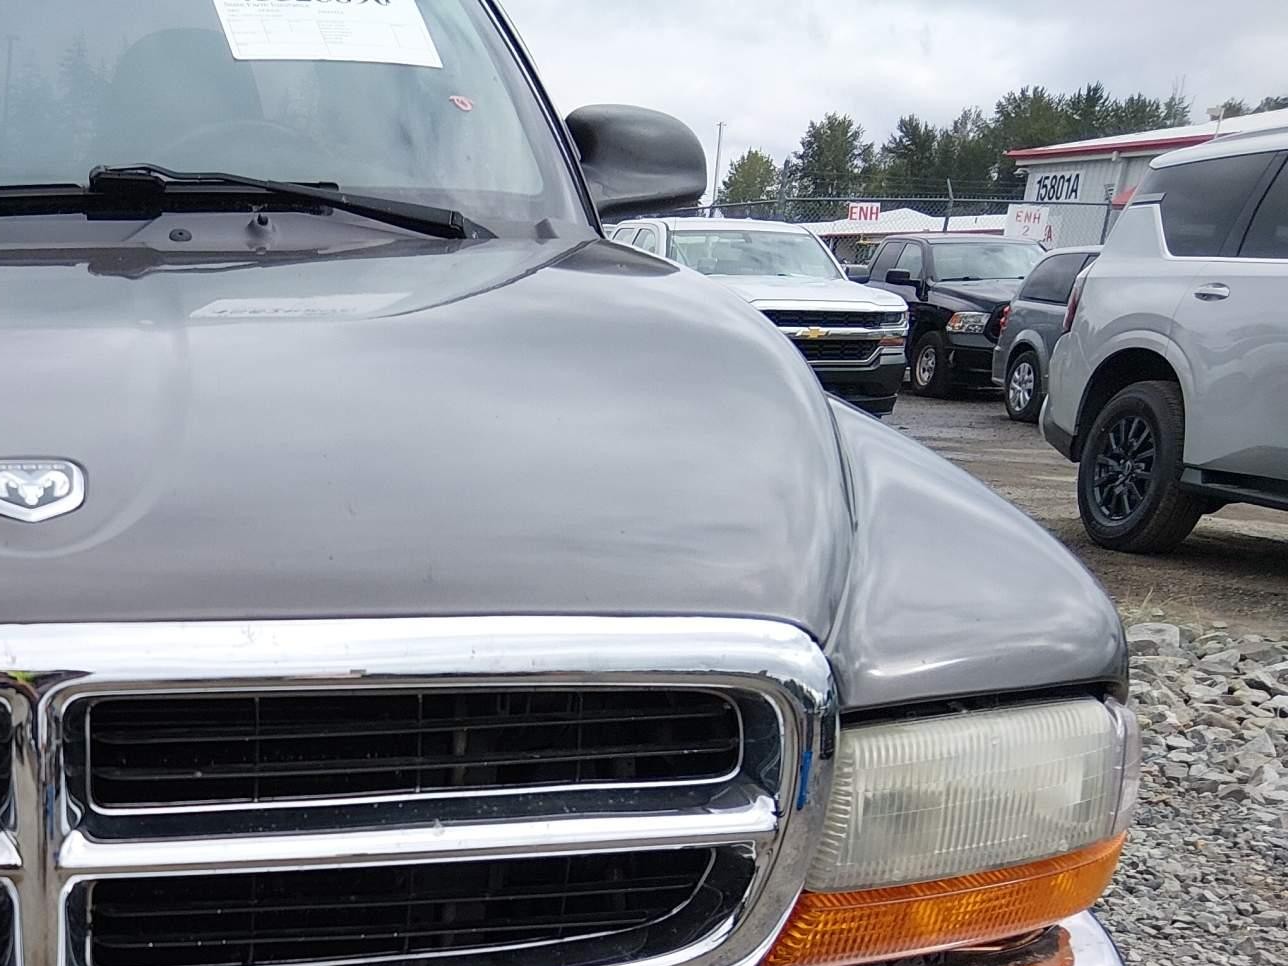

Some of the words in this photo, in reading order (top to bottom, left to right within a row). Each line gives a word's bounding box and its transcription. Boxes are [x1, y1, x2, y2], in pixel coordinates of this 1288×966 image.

[1035, 173, 1080, 201] 15801A
[849, 206, 879, 221] ENH
[1016, 210, 1041, 224] ENH
[1022, 225, 1029, 236] 2
